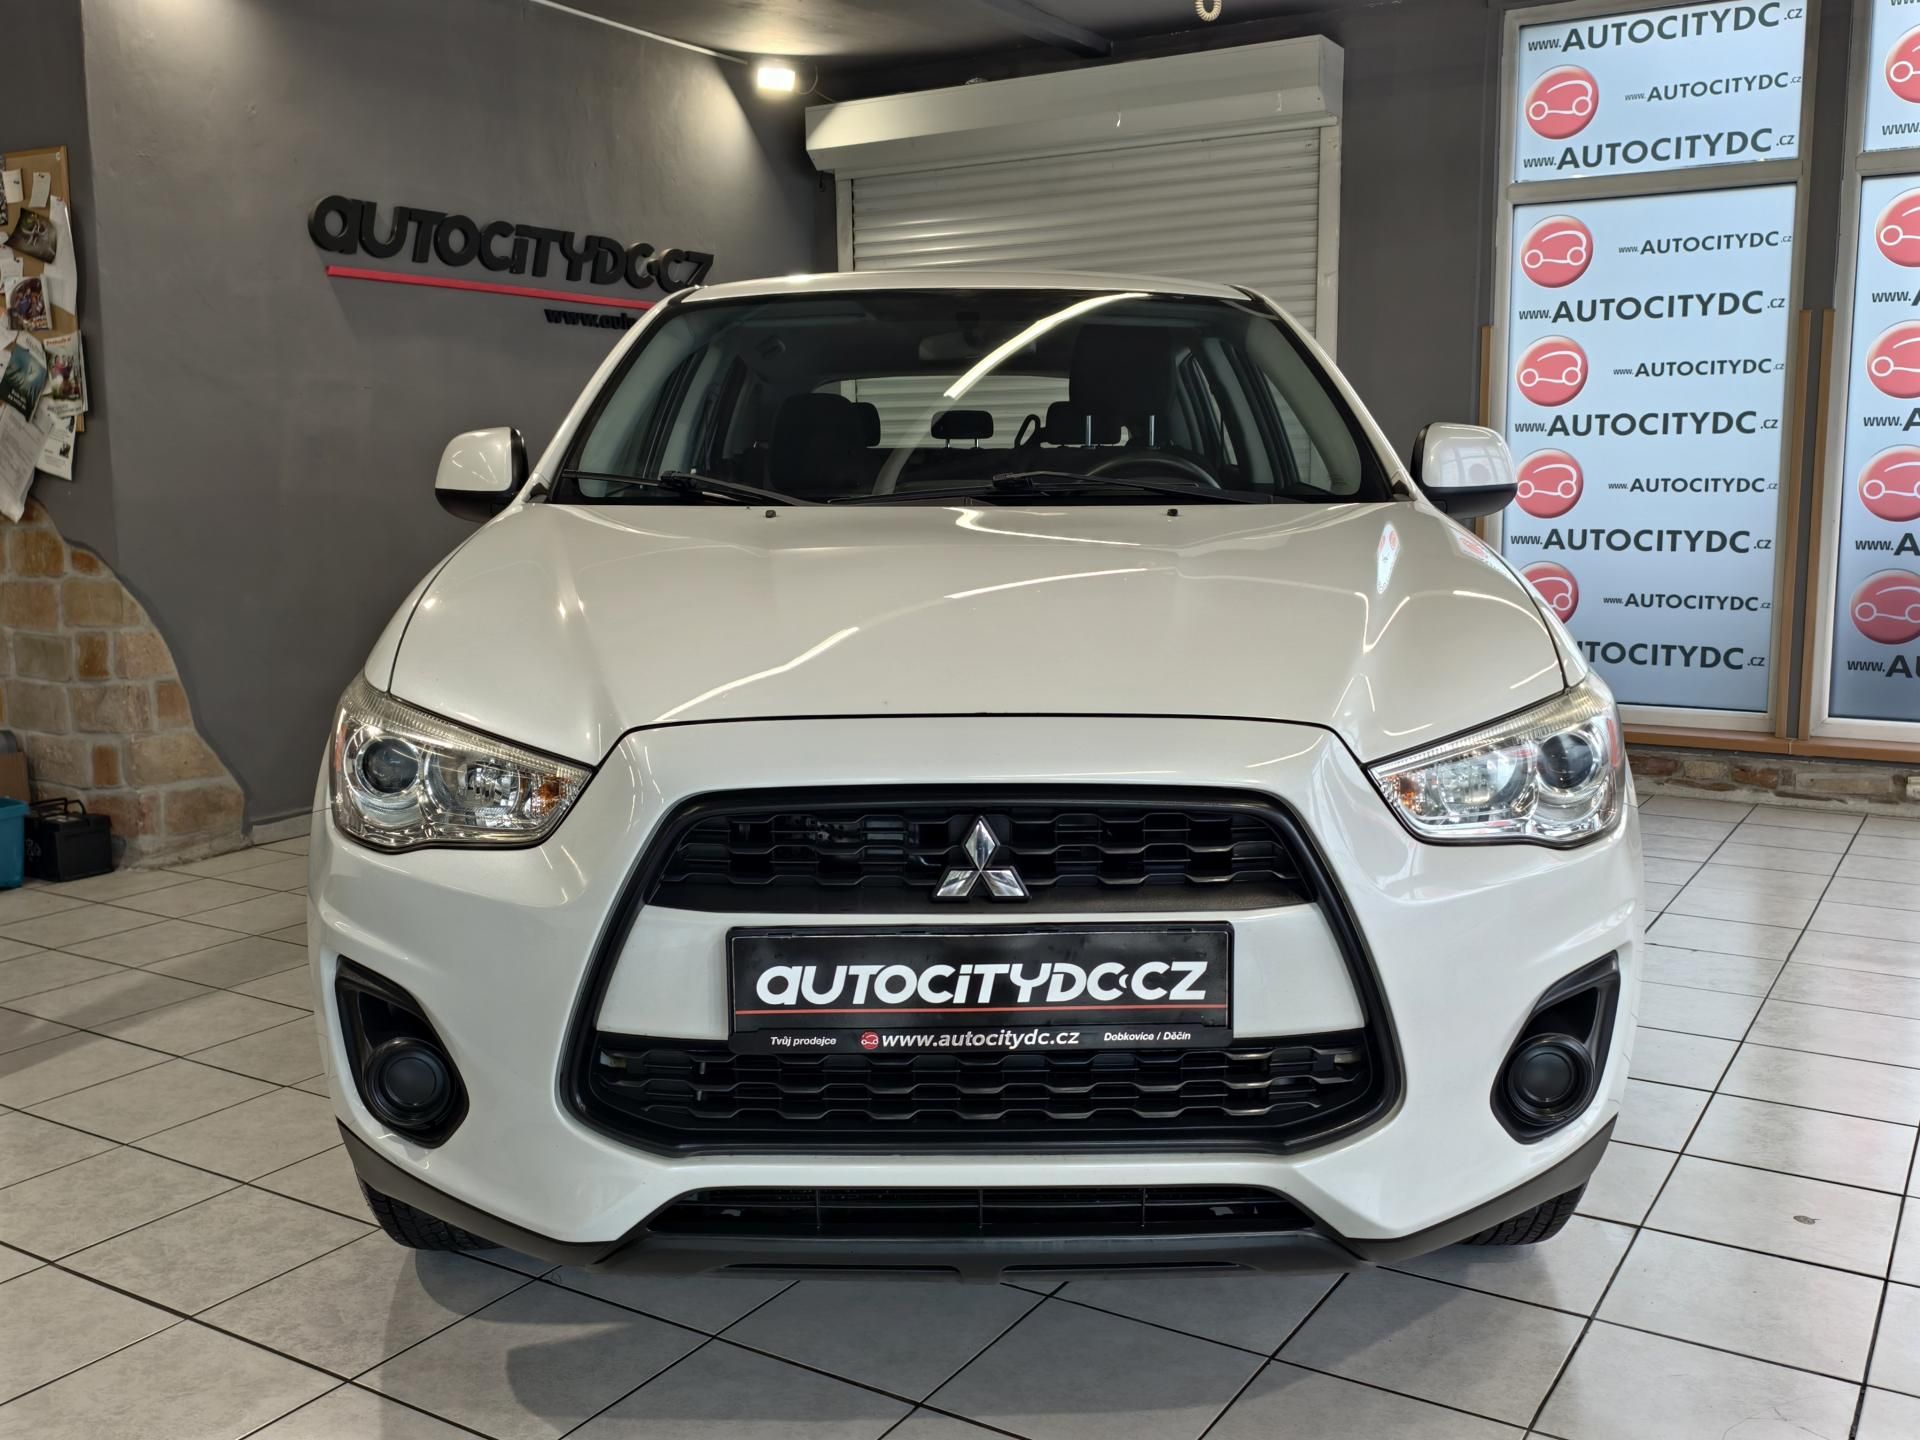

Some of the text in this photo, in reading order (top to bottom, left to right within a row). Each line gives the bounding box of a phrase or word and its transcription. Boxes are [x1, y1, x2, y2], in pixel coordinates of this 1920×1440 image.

[1527, 2, 1803, 53] www.AUTOCITYDC.cz
[1624, 71, 1802, 102] www.AUTOCITYDC.cz
[1523, 128, 1795, 171] www.AUTOCITYDC.cz
[1618, 231, 1792, 256] www.AUTOCITYDC.cz
[1519, 290, 1785, 323] www.AUTOCITYDC.cz
[1613, 358, 1785, 378] www.AUTOCITYDC.cz
[1514, 410, 1778, 437] www.AUTOCITYDC.cz
[1608, 477, 1778, 493] www.AUTOCITYDC.cz
[1510, 528, 1772, 554] www.AUTOCITYDC.cz
[793, 1036, 837, 1047] prodejce
[882, 1029, 1080, 1048] www.autocitydc.cz
[1104, 1032, 1154, 1041] Dobkovice
